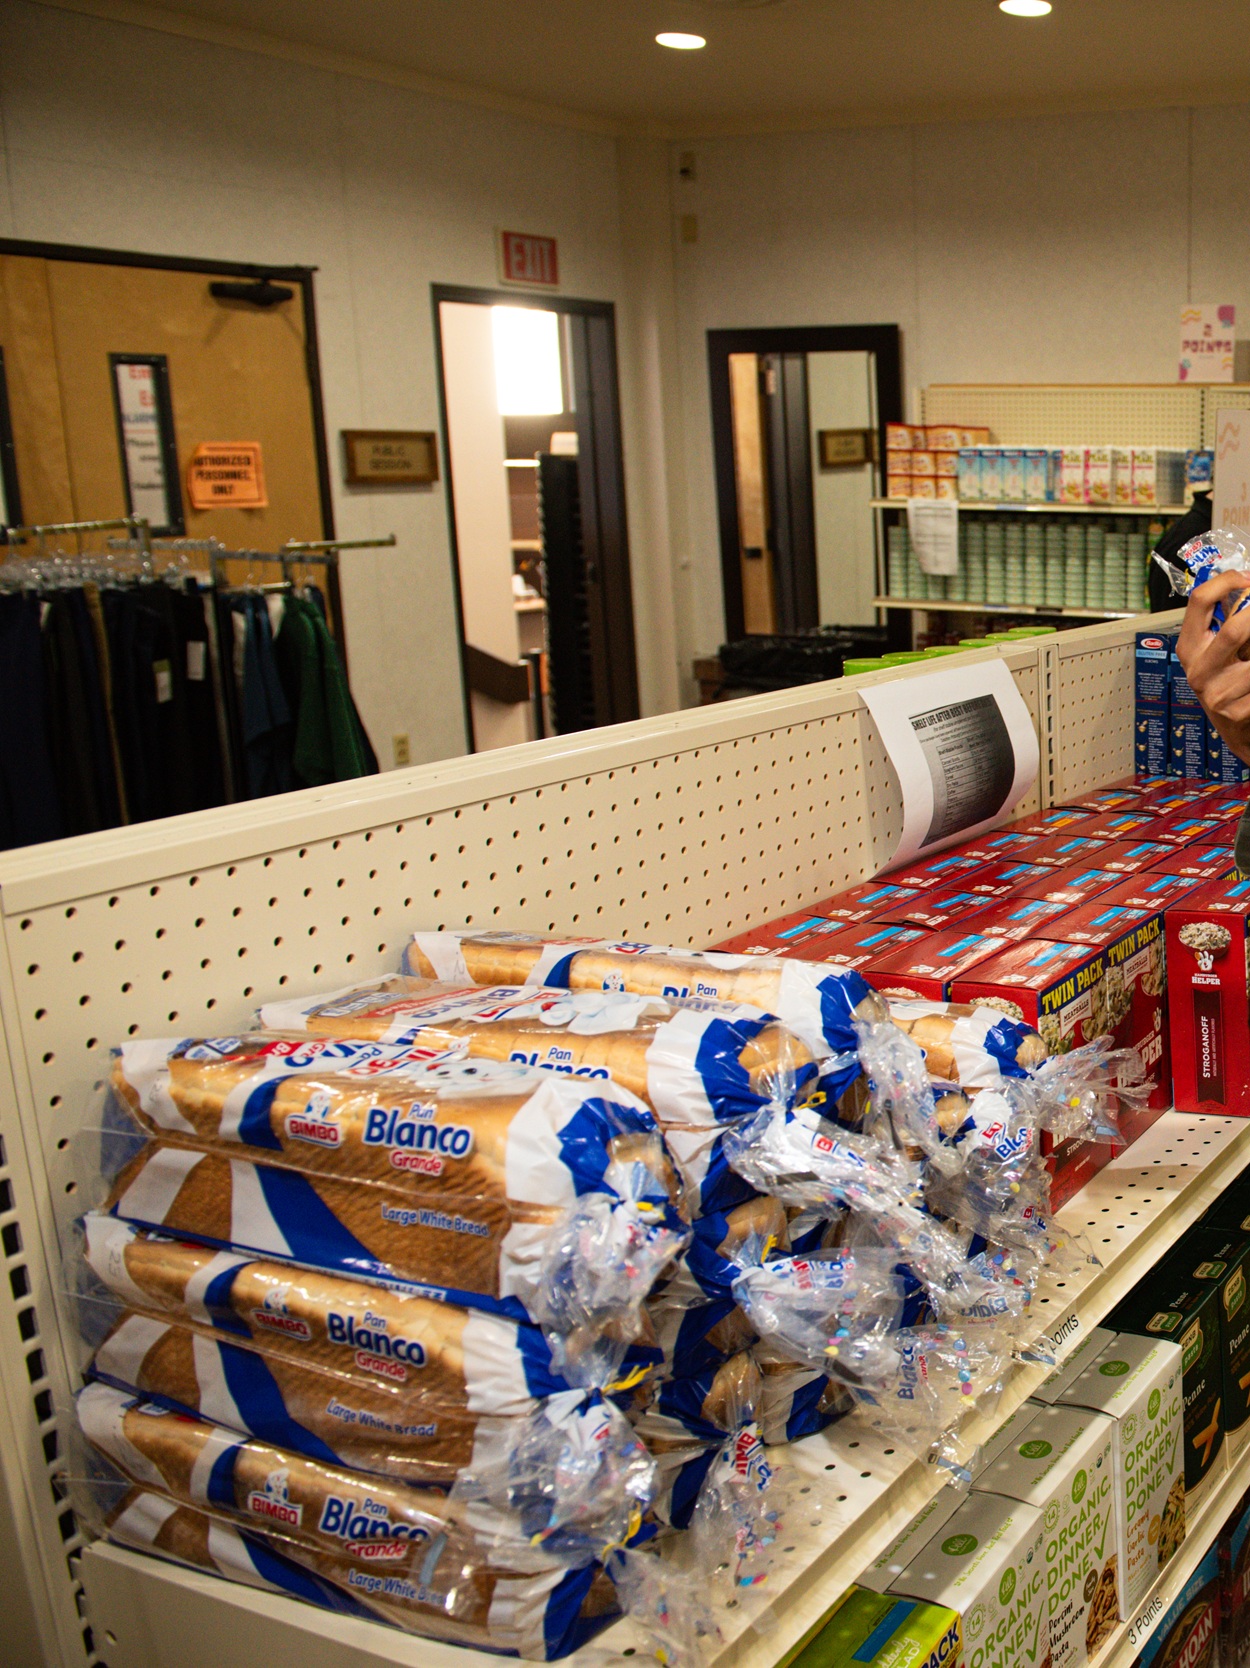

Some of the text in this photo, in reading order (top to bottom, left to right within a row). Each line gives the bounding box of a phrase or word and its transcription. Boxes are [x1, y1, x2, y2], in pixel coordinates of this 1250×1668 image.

[512, 237, 551, 281] EXIT
[1182, 340, 1232, 353] POINTS
[1108, 917, 1160, 965] TWIN PACK
[697, 984, 718, 997] Pan
[1042, 960, 1103, 1014] TWIN PACK
[1192, 976, 1220, 985] HELPER
[1063, 998, 1089, 1021] MEATBALLS
[548, 1047, 571, 1061] Pan
[1202, 1016, 1211, 1078] STROGANOFF
[288, 1119, 339, 1144] BIMBO
[364, 1107, 472, 1157] Blanco
[389, 1151, 443, 1176] Grande
[382, 1202, 489, 1236] Large White Bread
[1169, 1291, 1189, 1308] Penne
[255, 1311, 309, 1336] BIMBO
[364, 1311, 386, 1328] Pan
[328, 1312, 426, 1366] Blanco
[1229, 1324, 1250, 1355] Penne
[356, 1351, 407, 1380] Grande
[1183, 1378, 1206, 1411] Penne
[326, 1398, 436, 1438] Large White Bread
[1124, 1396, 1181, 1473] ORGANIC.
[1126, 1431, 1174, 1499] DINNER.
[364, 1498, 387, 1516] Pan
[1126, 1465, 1166, 1523] DONE.
[251, 1497, 299, 1526] BIMBO
[321, 1498, 430, 1543] Blanco
[1046, 1475, 1111, 1563] ORGANIC.
[1126, 1509, 1149, 1538] Creamy
[345, 1539, 408, 1560] Grande
[1047, 1514, 1104, 1590] DINNER.
[1127, 1529, 1145, 1555] Garlic
[1127, 1547, 1144, 1572] Pasta
[349, 1569, 381, 1593] Large
[383, 1576, 416, 1600] White
[1048, 1552, 1094, 1616] DONE.
[970, 1570, 1044, 1668] ORGANIC.
[1049, 1599, 1074, 1633] Porcini
[1050, 1605, 1085, 1648] Mushroom
[1128, 1597, 1163, 1645] 3 Points
